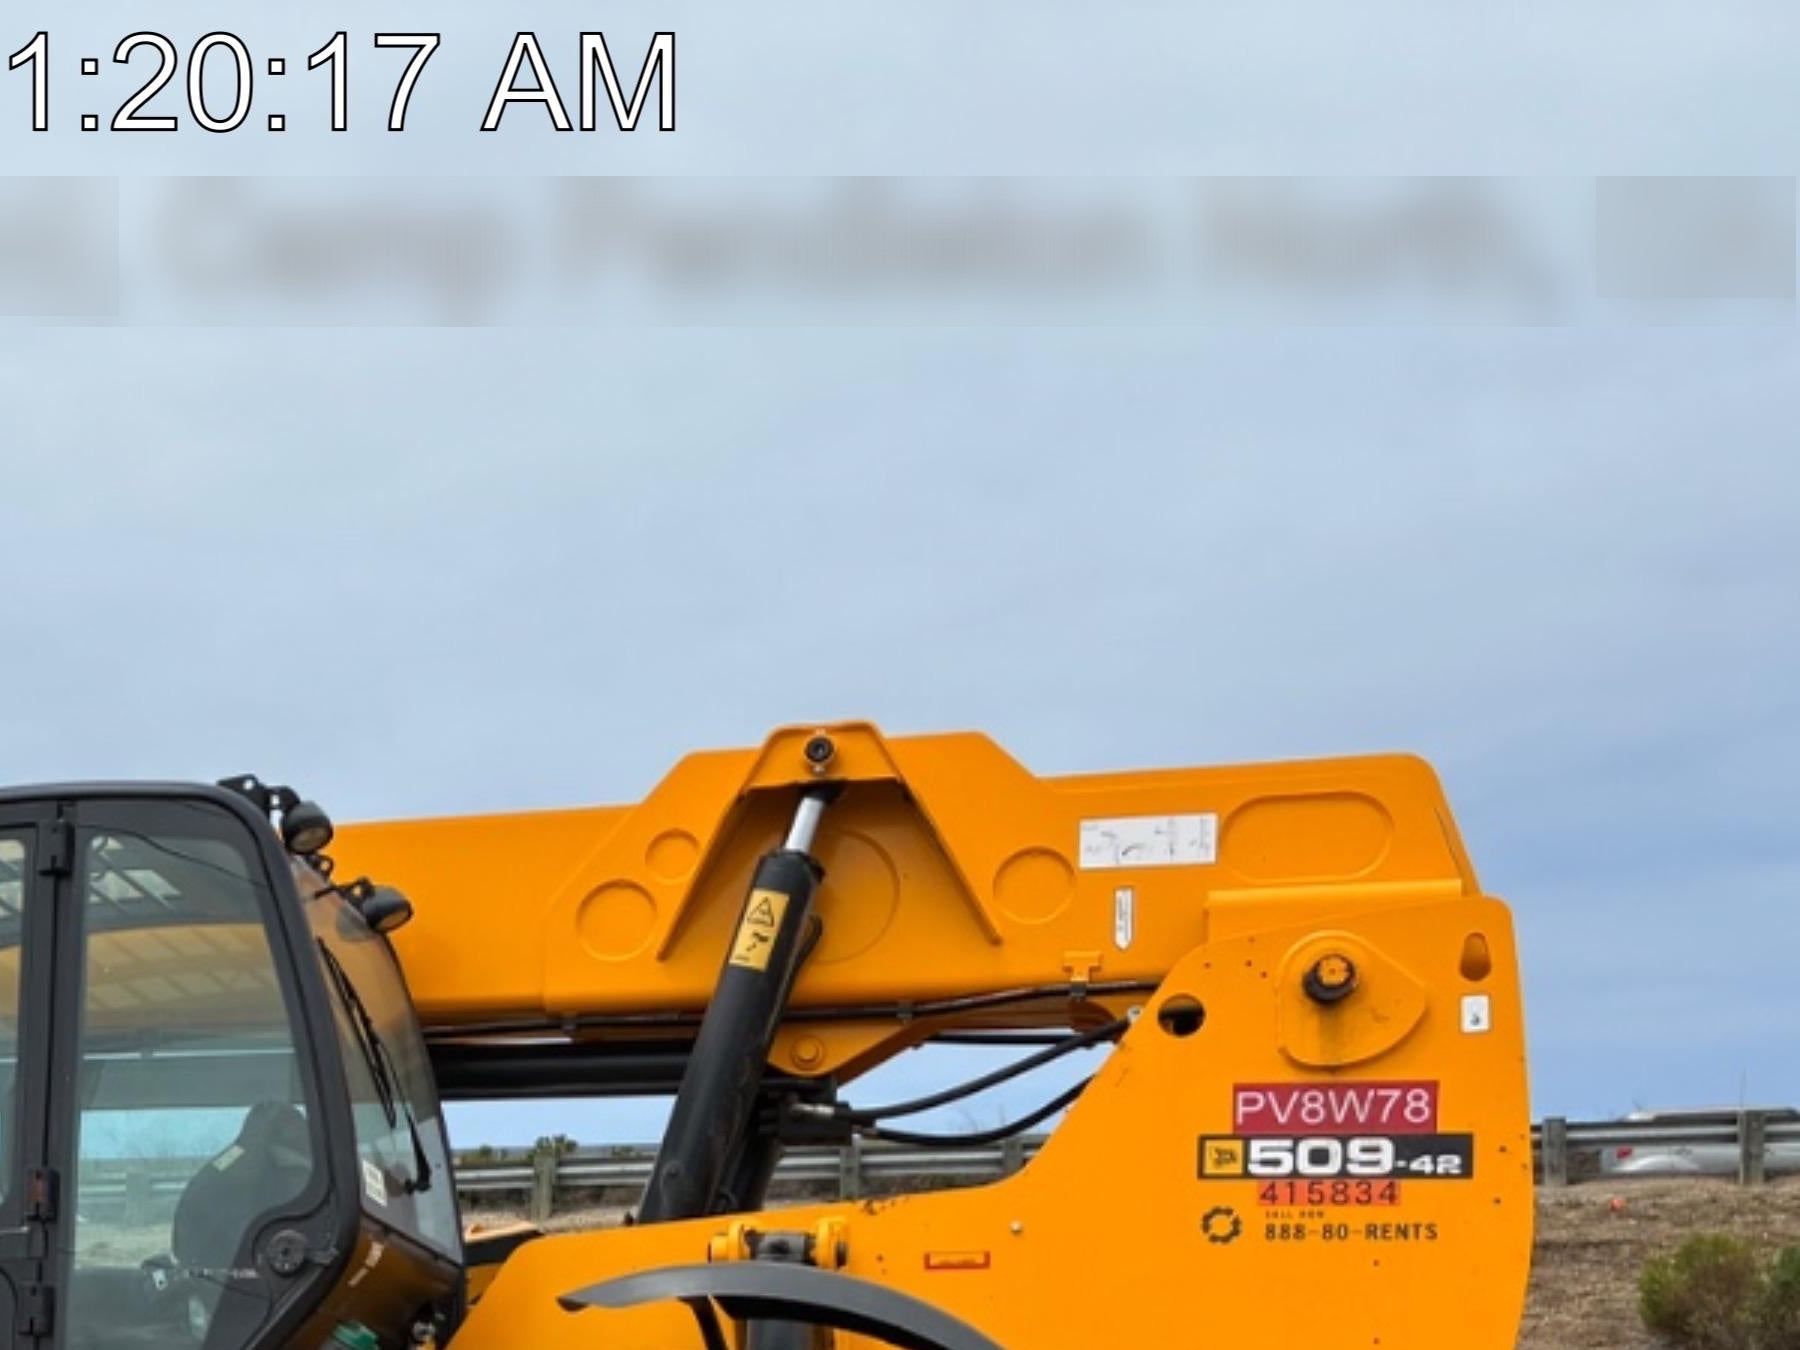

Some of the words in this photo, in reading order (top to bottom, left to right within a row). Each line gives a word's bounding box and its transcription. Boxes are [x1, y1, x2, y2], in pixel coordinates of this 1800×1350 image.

[1236, 1088, 1430, 1125] PV8W78
[1260, 1181, 1398, 1205] 415834
[1265, 1223, 1438, 1241] 888-80-RENTS
